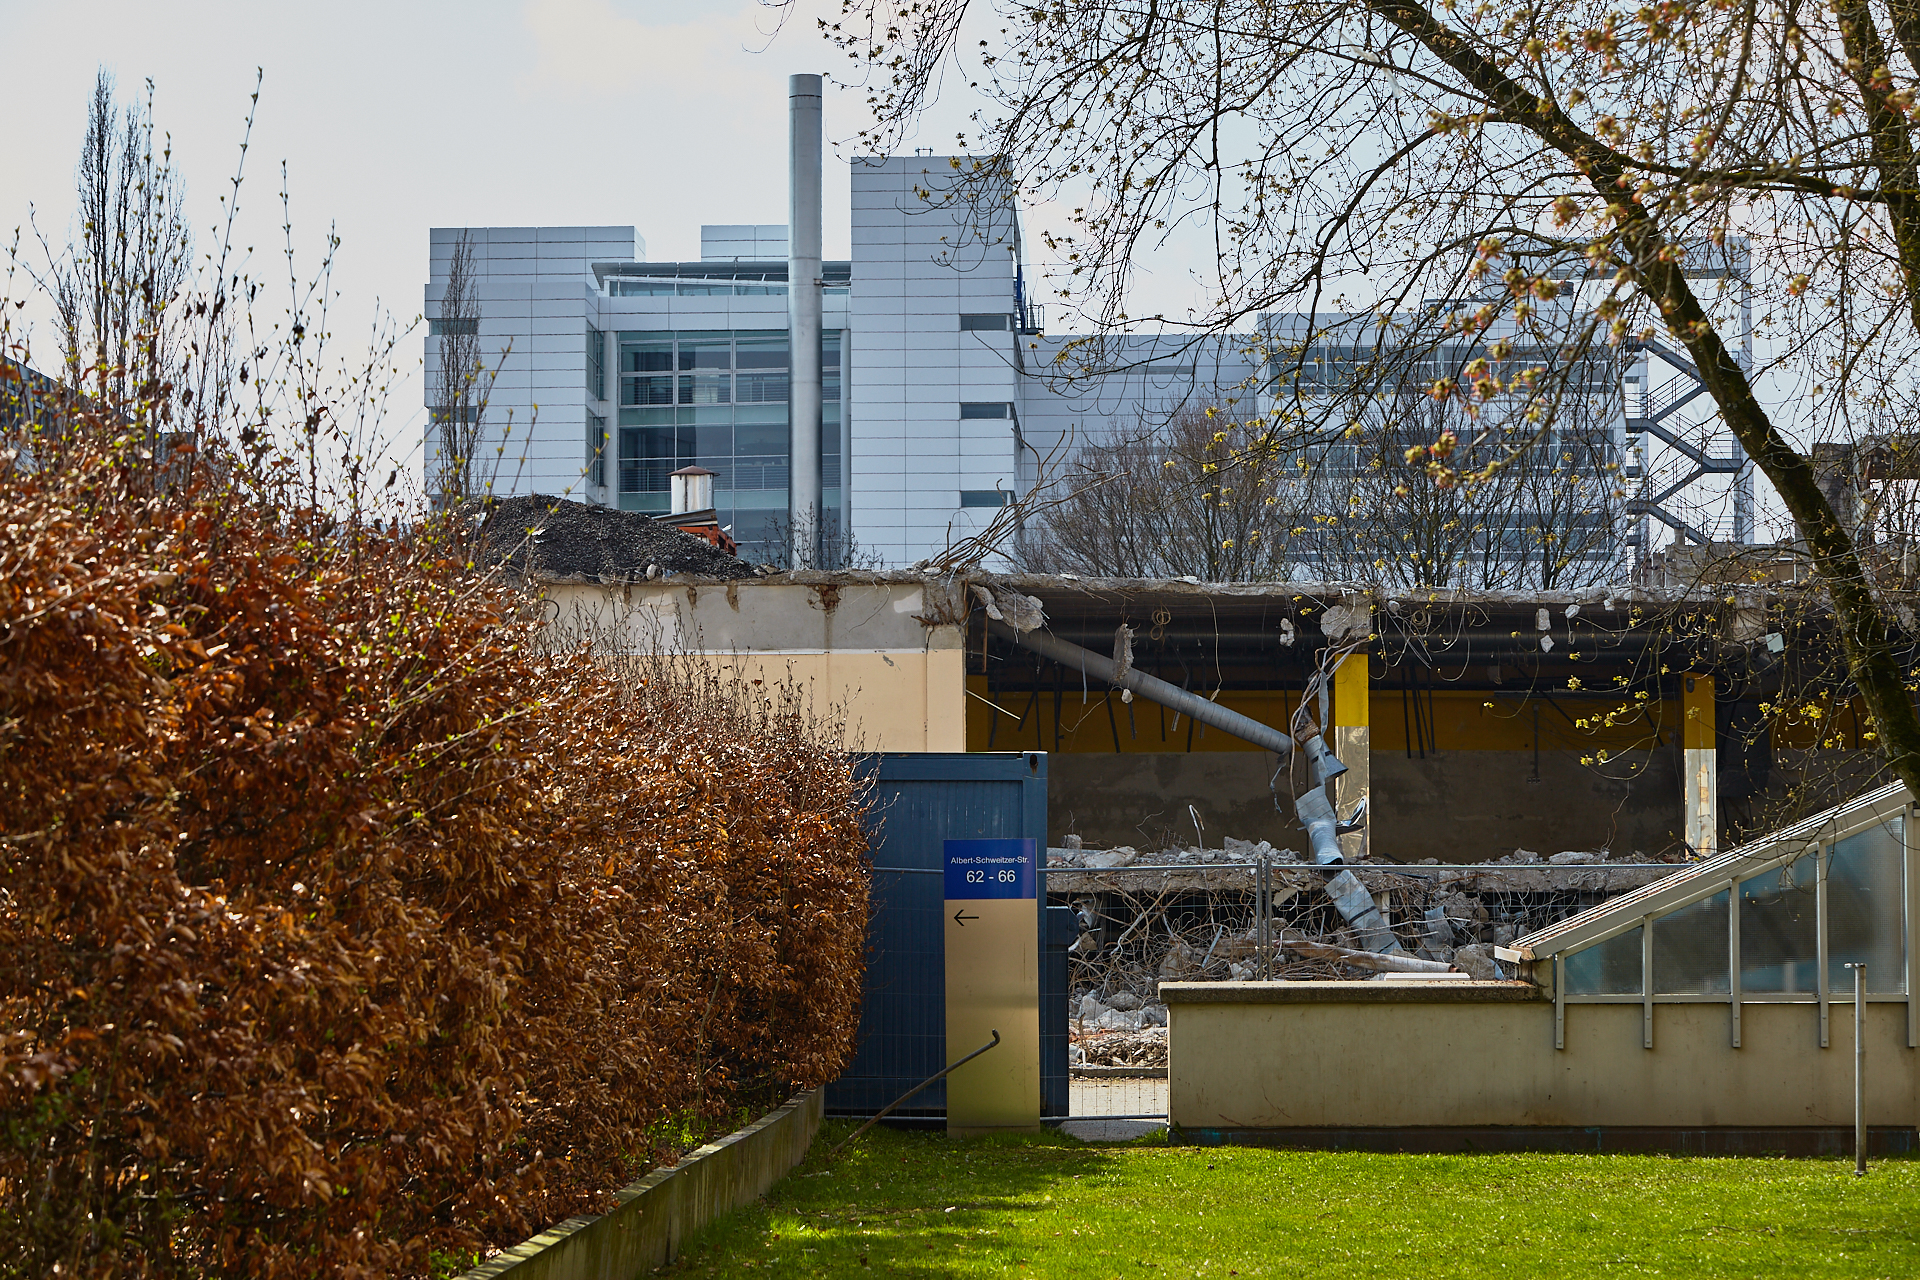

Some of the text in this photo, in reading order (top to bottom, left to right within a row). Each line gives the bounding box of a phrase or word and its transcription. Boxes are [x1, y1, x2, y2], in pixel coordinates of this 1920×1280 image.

[950, 856, 1029, 864] Albert-Schweitzer-Str.
[966, 870, 984, 883] 62
[998, 870, 1016, 882] 66
